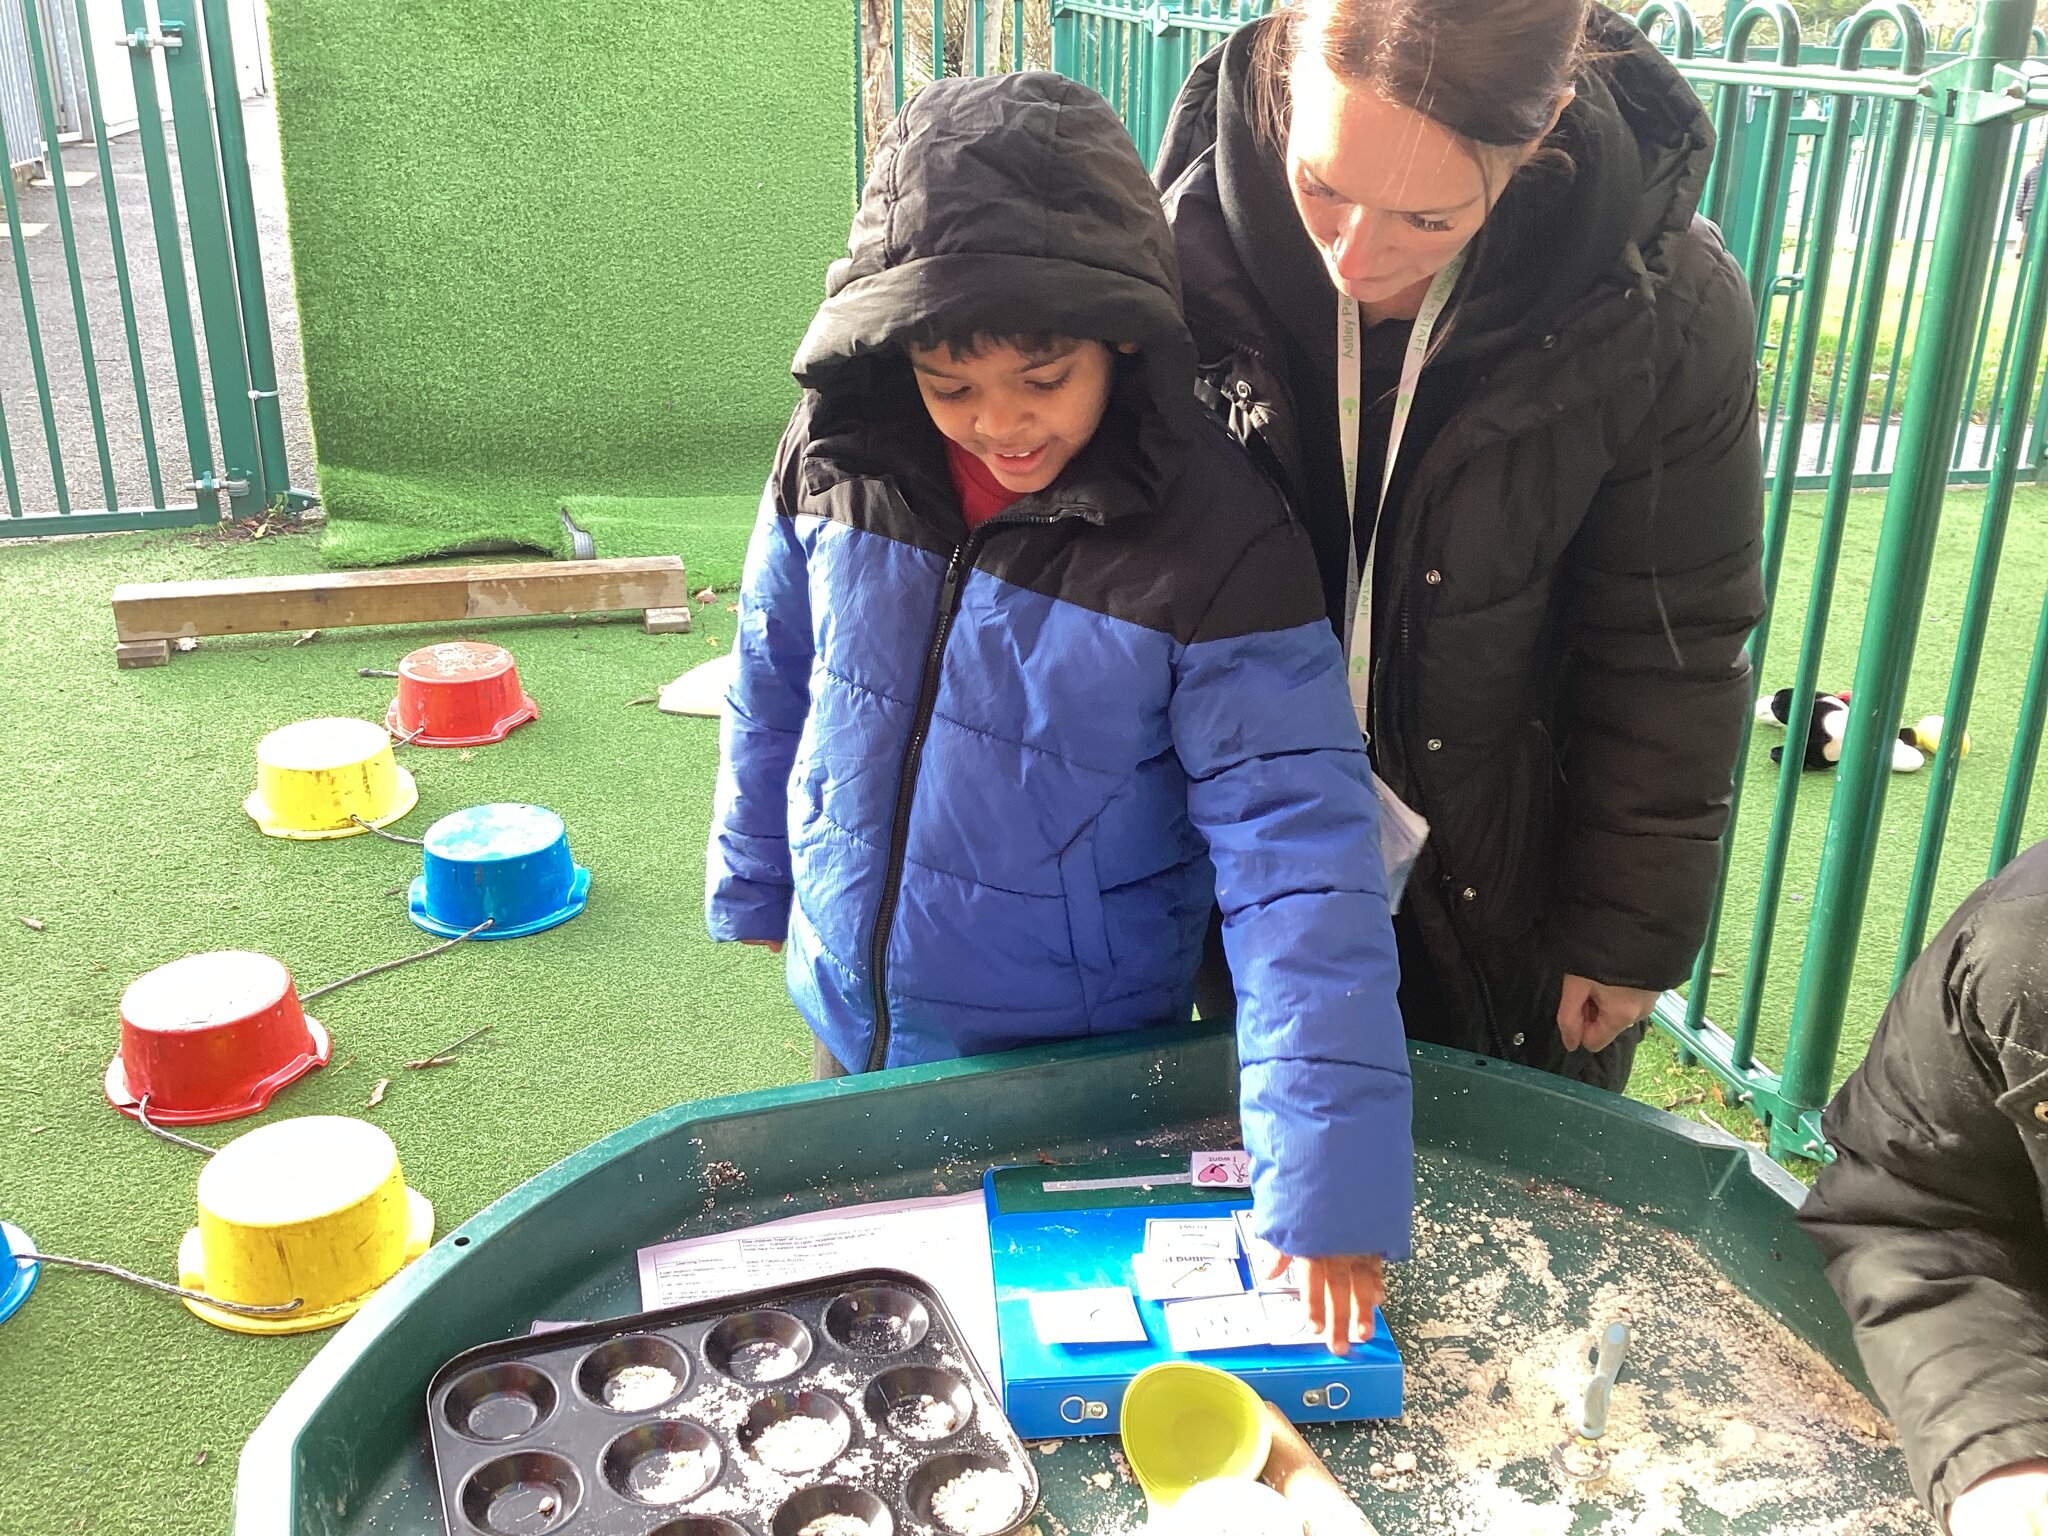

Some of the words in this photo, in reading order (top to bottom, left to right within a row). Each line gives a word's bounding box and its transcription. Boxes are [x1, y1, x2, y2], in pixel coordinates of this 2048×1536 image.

[1341, 320, 1357, 359] Astley
[1413, 312, 1435, 356] STAFF
[1359, 577, 1372, 620] STAFF
